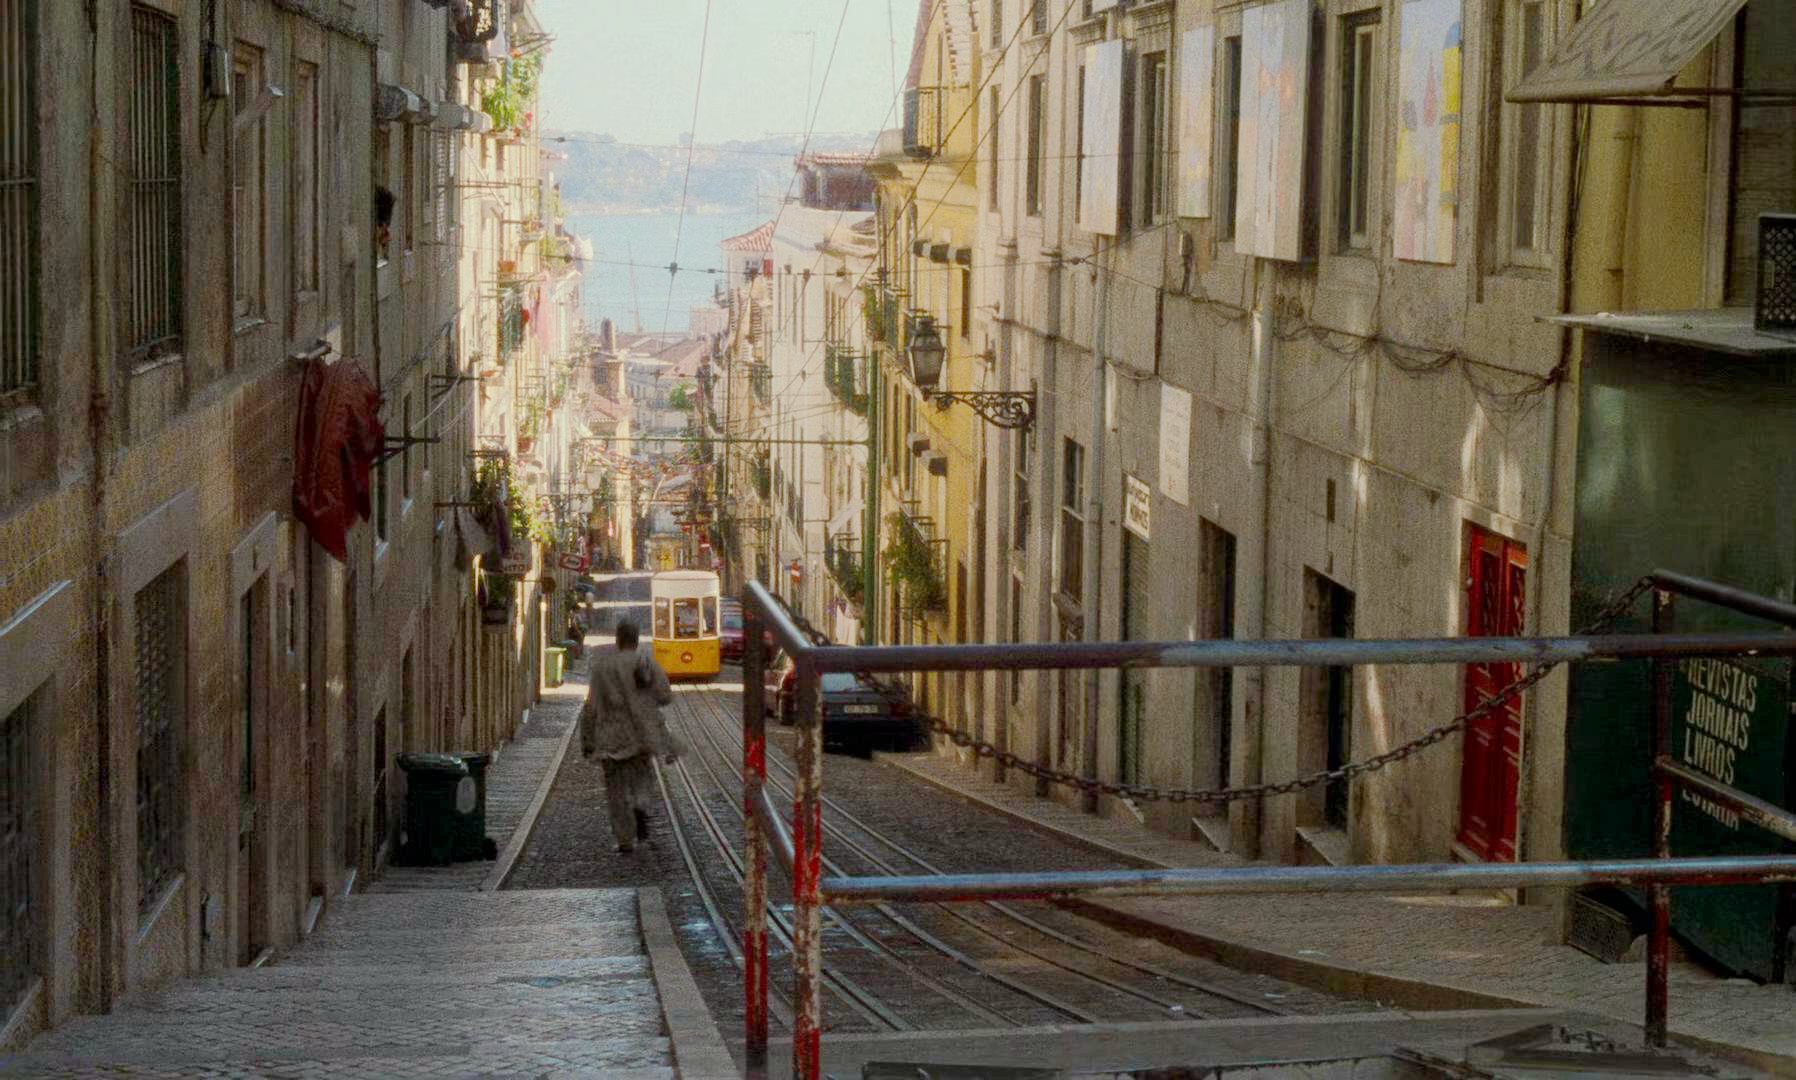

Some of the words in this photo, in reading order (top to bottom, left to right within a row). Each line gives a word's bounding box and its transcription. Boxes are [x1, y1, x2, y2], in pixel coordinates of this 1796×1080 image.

[1688, 657, 1757, 712] REVISTAS
[1686, 690, 1750, 750] JORNAIS
[1684, 727, 1735, 785] LIVROS
